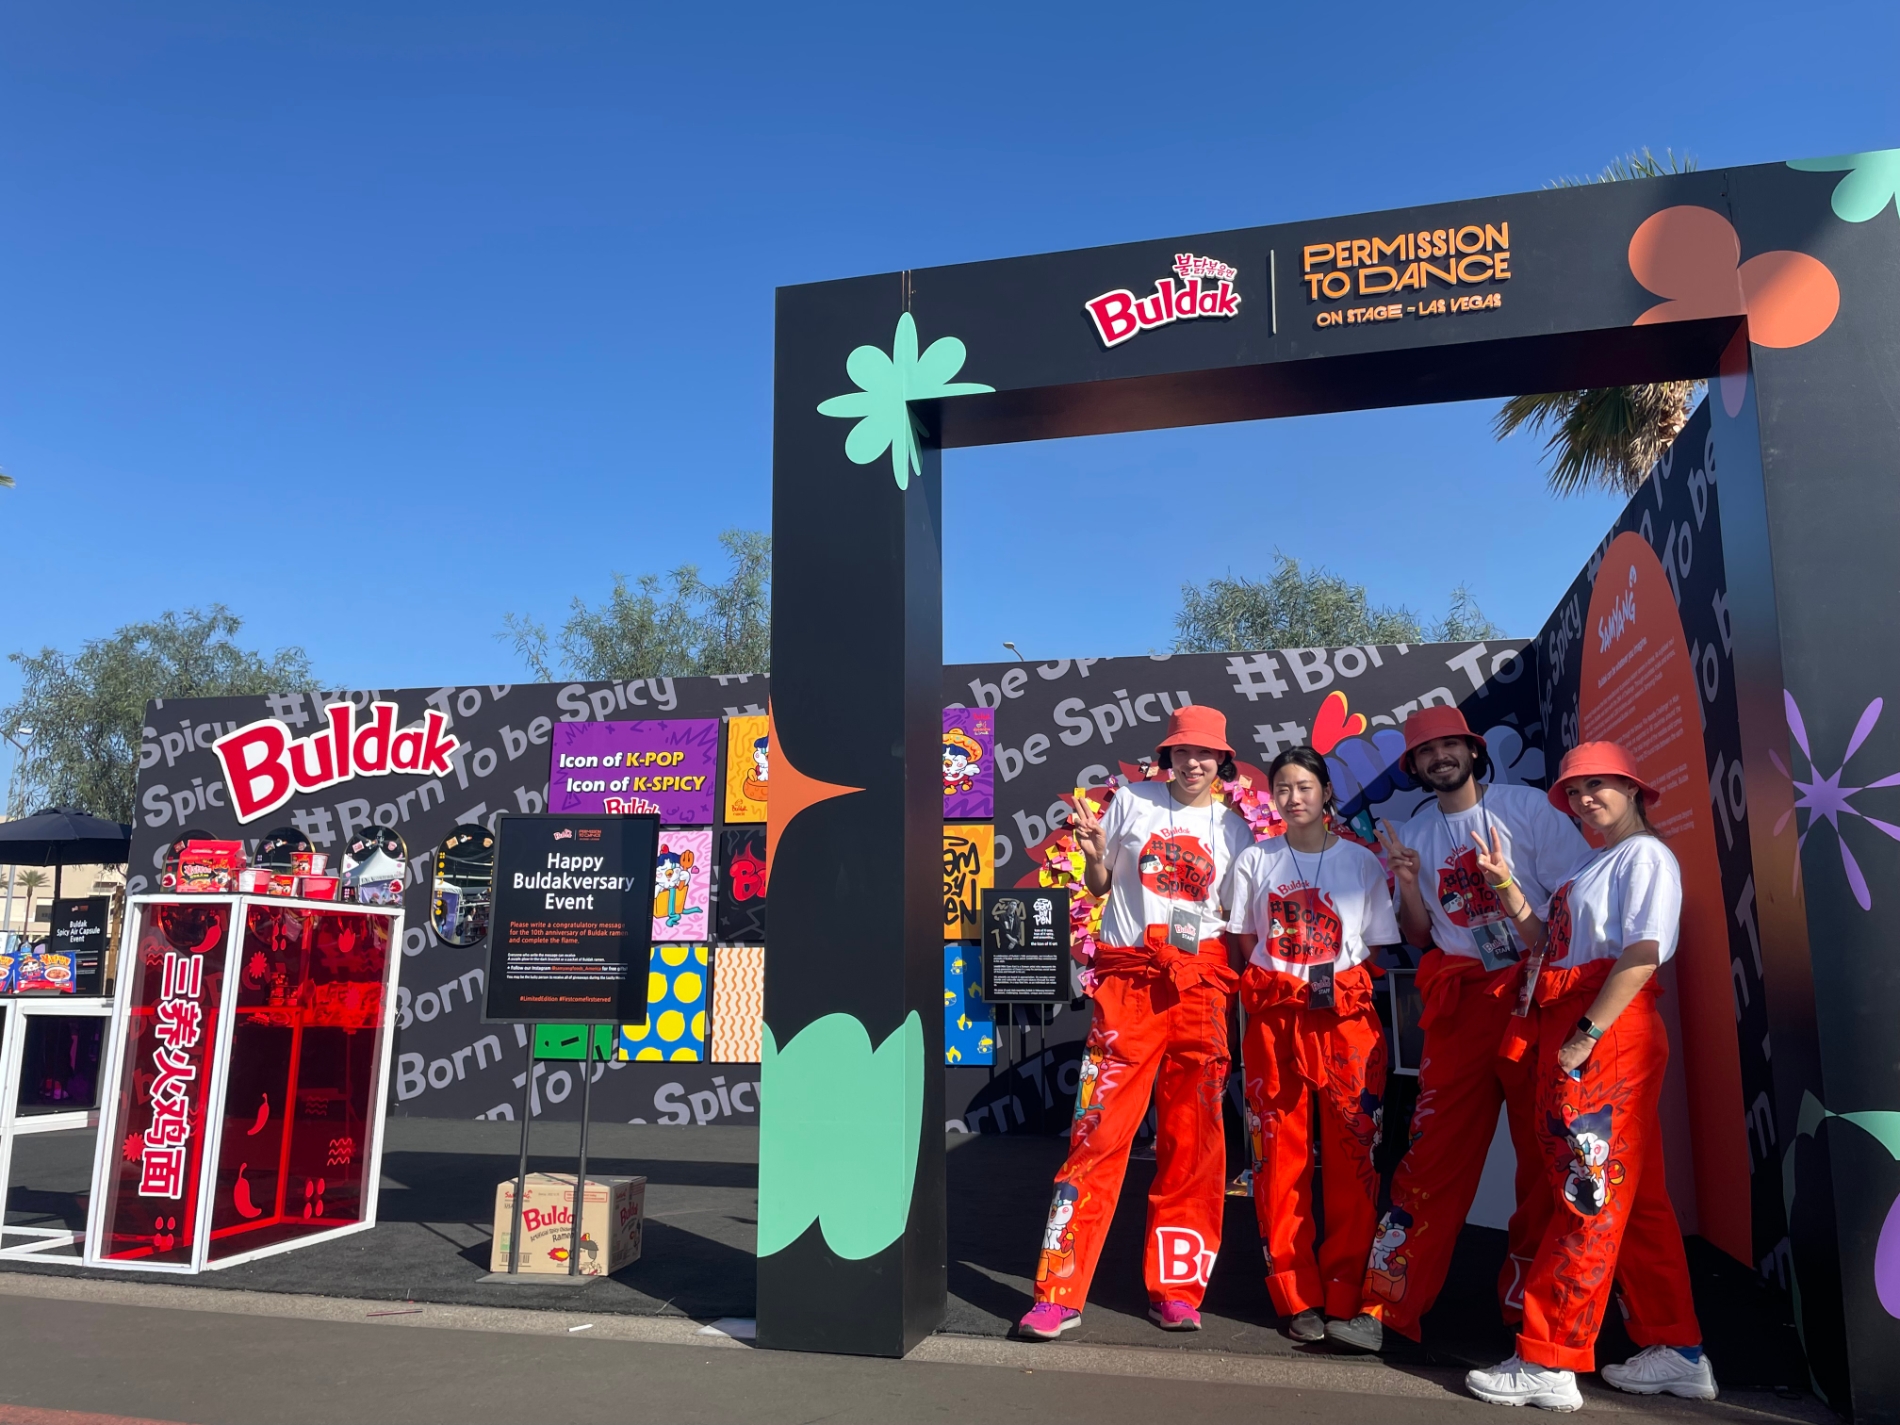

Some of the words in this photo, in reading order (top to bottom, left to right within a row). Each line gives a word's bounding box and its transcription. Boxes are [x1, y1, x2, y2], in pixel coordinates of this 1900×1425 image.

[1172, 253, 1237, 280] 불닭볶음면
[1304, 222, 1510, 273] PERMISSION
[1304, 271, 1352, 300] TO
[1358, 252, 1511, 295] DANCE
[1085, 278, 1241, 348] Buldak
[1316, 309, 1343, 327] ON
[1346, 303, 1403, 324] STAGE
[1418, 298, 1446, 315] LAS
[1450, 293, 1502, 313] VEGAS
[1549, 593, 1583, 686] Spicy
[1598, 589, 1636, 653] SAMYANG
[968, 667, 1028, 711] be
[1445, 642, 1524, 698] To
[556, 676, 679, 722] Spicy
[498, 716, 552, 761] be
[559, 752, 597, 768] Icon
[602, 751, 623, 768] of
[626, 751, 684, 767] K-POP
[993, 732, 1051, 783] be
[212, 701, 460, 824] Buldak
[566, 777, 605, 793] Icon
[609, 776, 630, 793] of
[633, 776, 705, 792] K-SPICY
[1709, 750, 1748, 850] To
[1012, 799, 1074, 849] be
[513, 872, 635, 892] Buldakversary
[547, 852, 604, 872] Happy
[544, 893, 594, 910] Event
[1156, 873, 1200, 898] Spicy
[56, 929, 70, 937] Spicy
[79, 926, 101, 935] Capsule
[69, 920, 88, 928] Buldak
[69, 935, 85, 943] Event
[552, 921, 598, 929] congratulatory
[599, 922, 626, 930] message
[1270, 901, 1339, 933] #Born
[1735, 873, 1763, 980] T
[395, 969, 485, 1029] Born
[138, 952, 204, 1199] 三养火鸡面
[396, 1035, 502, 1101] Born
[512, 1062, 572, 1117] To
[1018, 1048, 1083, 1112] To
[522, 1205, 575, 1232] Bulda
